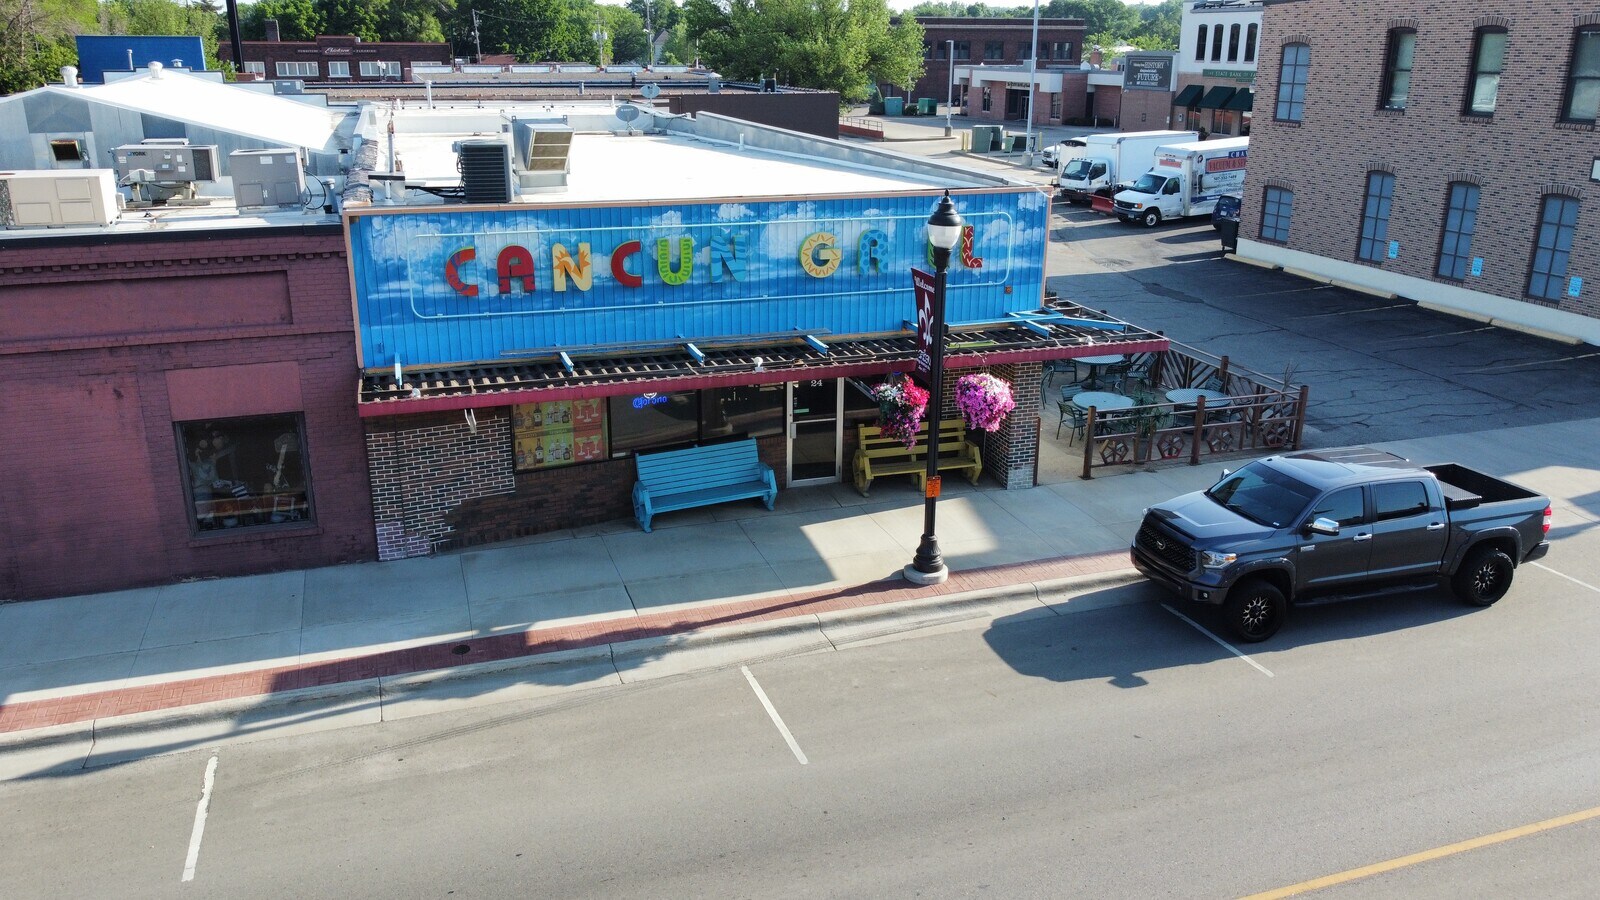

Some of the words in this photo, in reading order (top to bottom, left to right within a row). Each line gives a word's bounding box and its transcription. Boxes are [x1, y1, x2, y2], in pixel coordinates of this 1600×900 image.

[1144, 61, 1164, 69] HISTORY
[1137, 72, 1159, 81] FUTURE
[445, 234, 747, 297] CANCUN
[810, 379, 823, 387] 24
[632, 396, 667, 409] Corona
